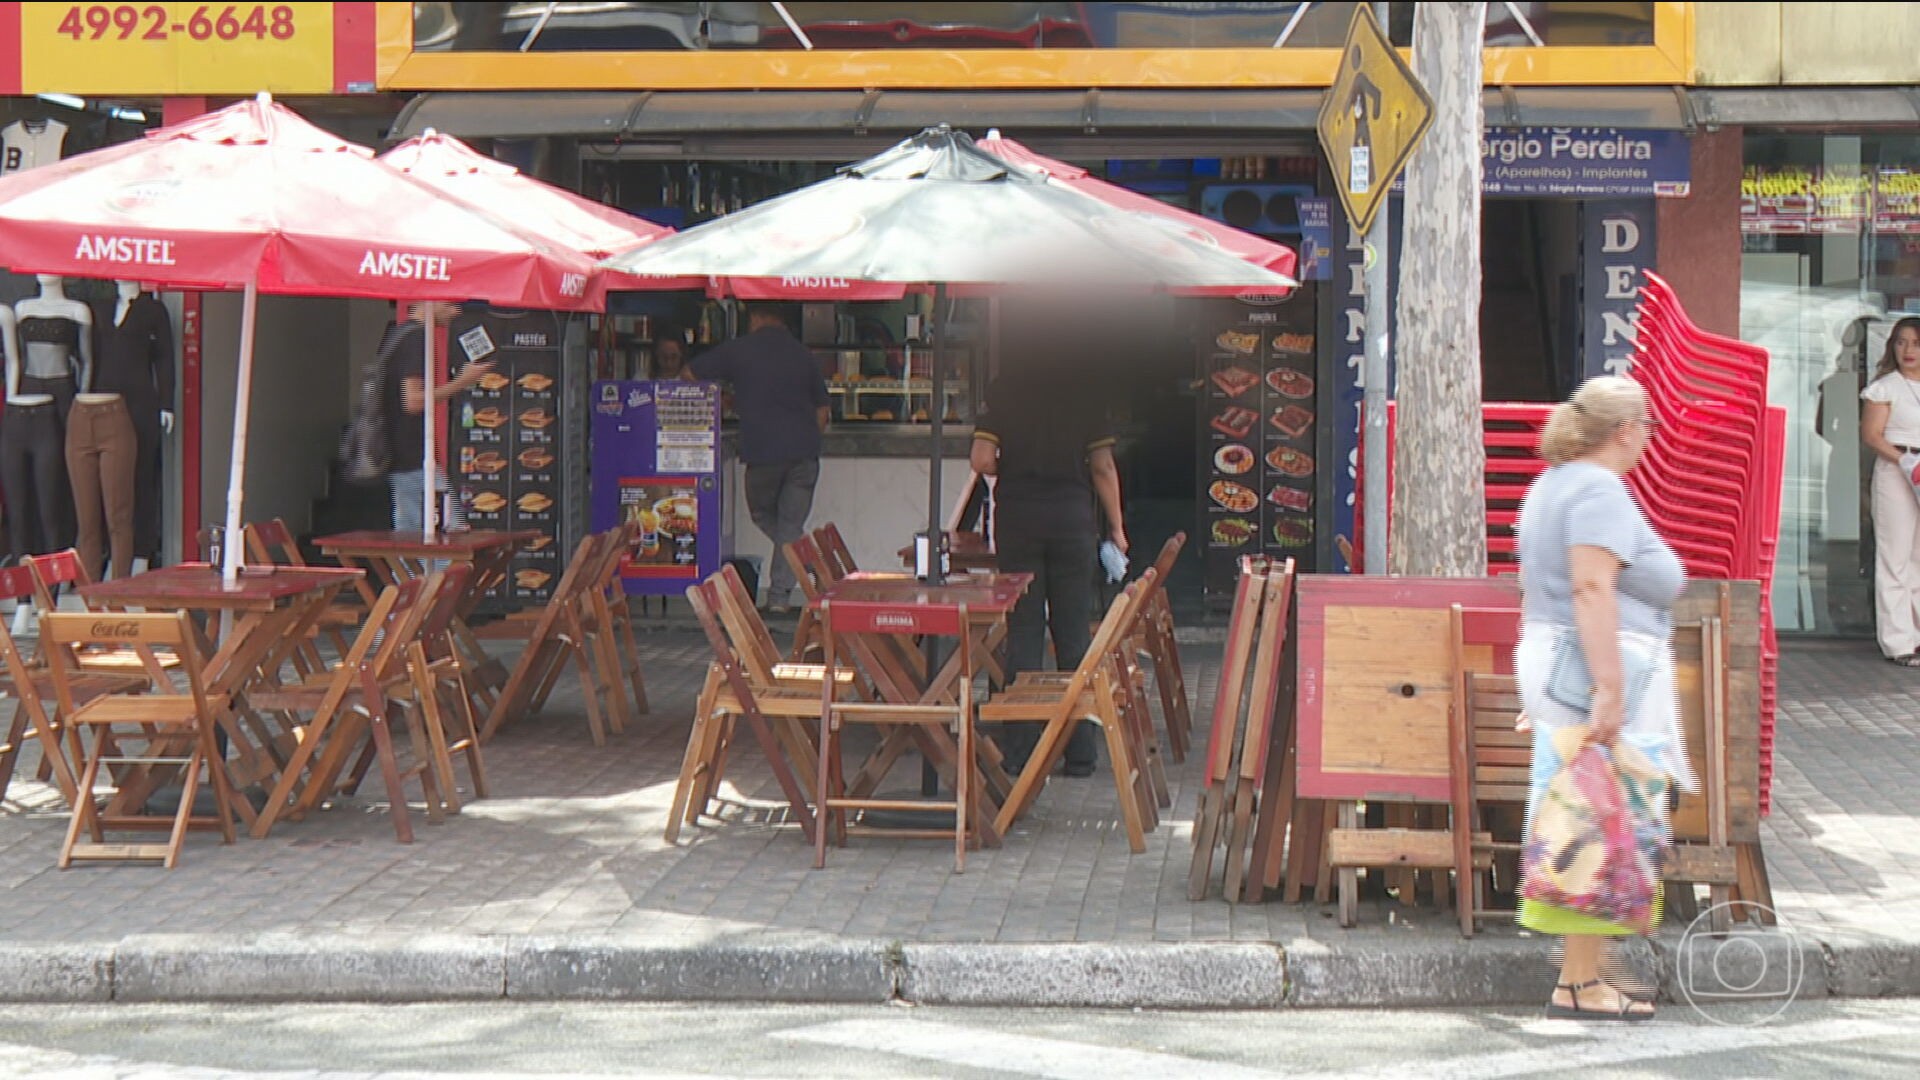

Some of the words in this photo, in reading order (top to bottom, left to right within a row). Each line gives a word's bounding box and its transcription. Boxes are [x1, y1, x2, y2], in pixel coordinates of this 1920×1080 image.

[57, 5, 296, 41] 4992-6648
[6, 146, 22, 170] B
[1551, 135, 1651, 159] Pereira
[1496, 166, 1572, 180] (Aparelhos)
[1582, 167, 1648, 180] Implantes
[75, 234, 176, 266] AMSTEL
[359, 250, 451, 281] AMSTEL
[875, 615, 914, 626] BRAHMA
